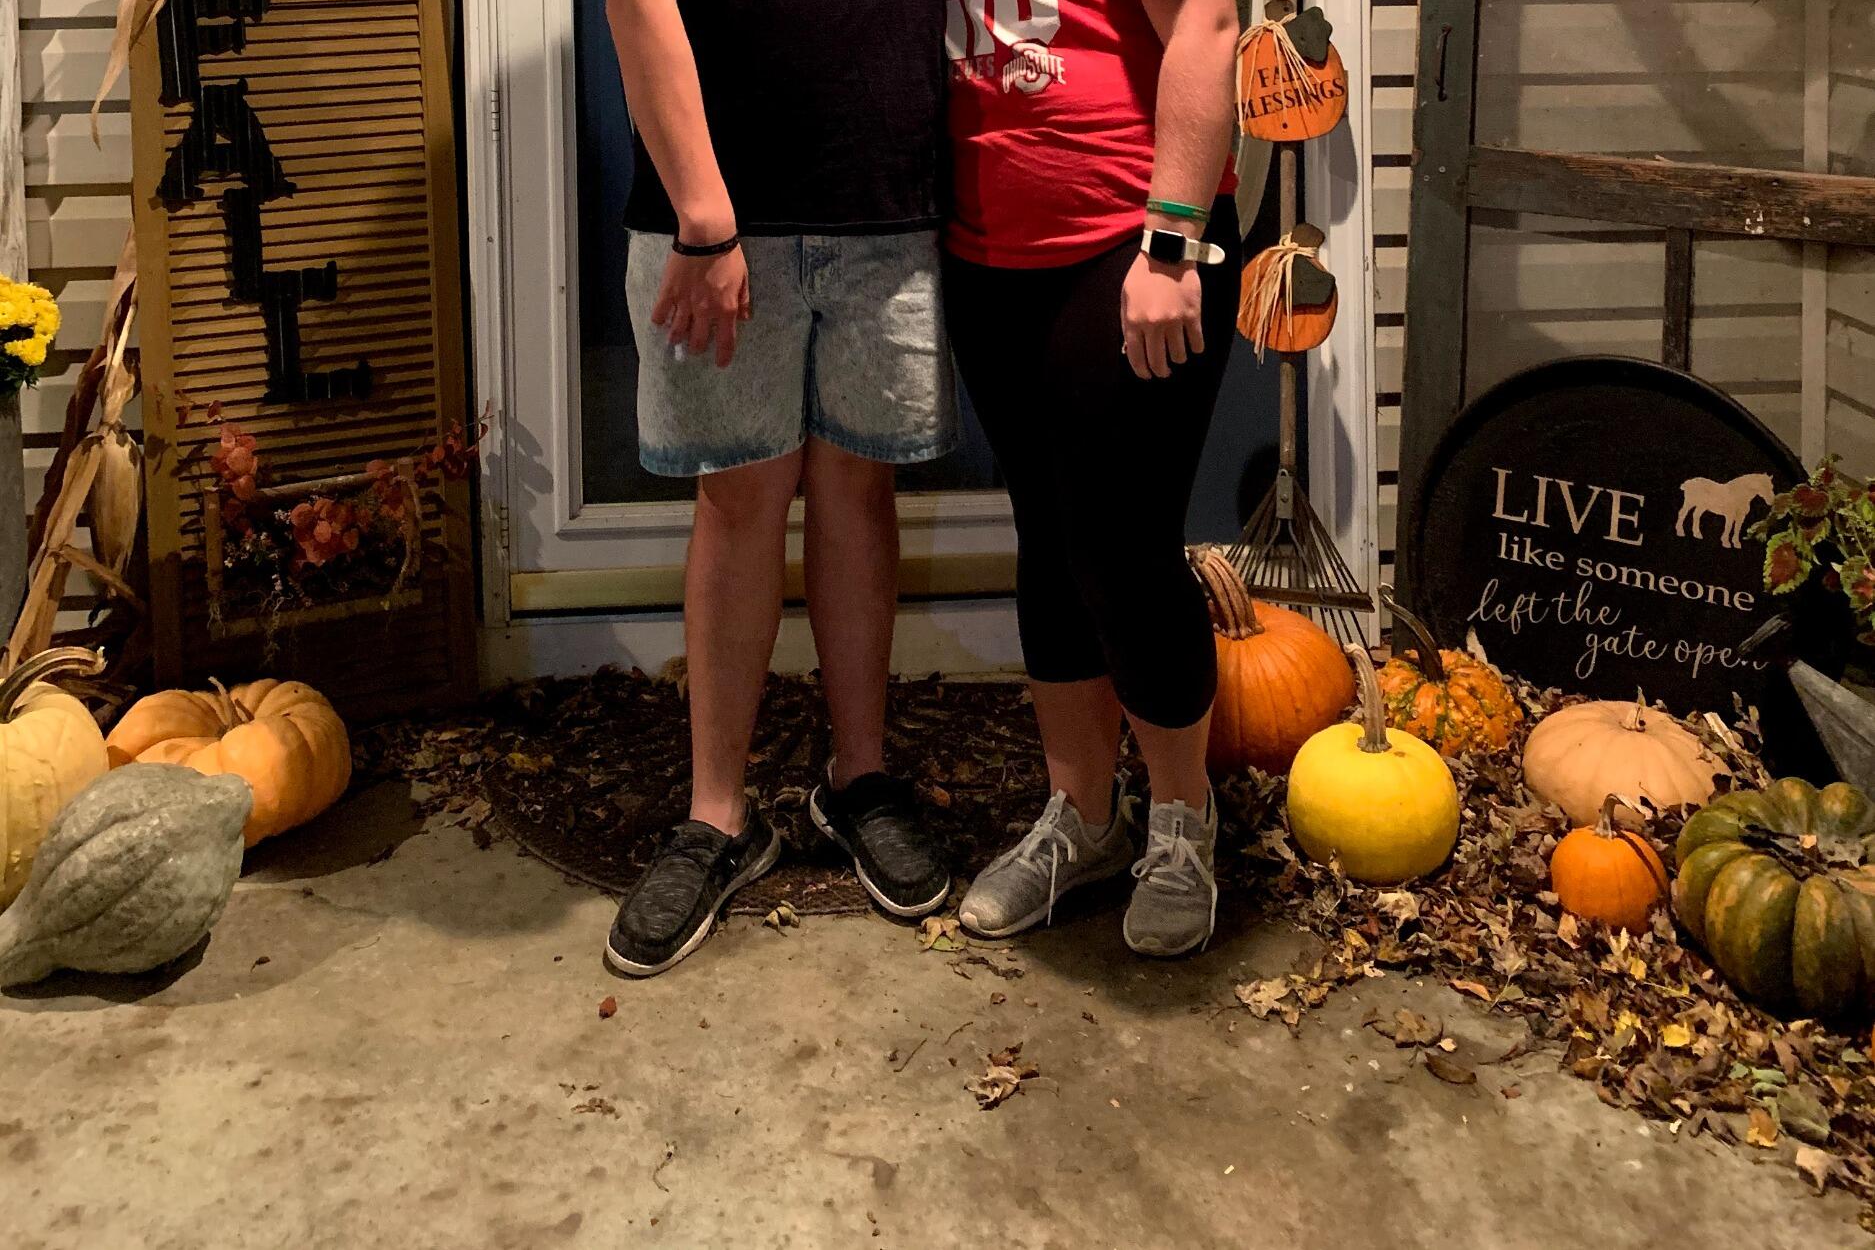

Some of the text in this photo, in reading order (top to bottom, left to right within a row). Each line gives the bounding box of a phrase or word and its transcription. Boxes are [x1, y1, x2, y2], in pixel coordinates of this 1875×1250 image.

[1491, 467, 1645, 547] LIVE
[1498, 532, 1755, 612] like someone
[1467, 578, 1622, 635] left the
[1575, 625, 1668, 680] gate
